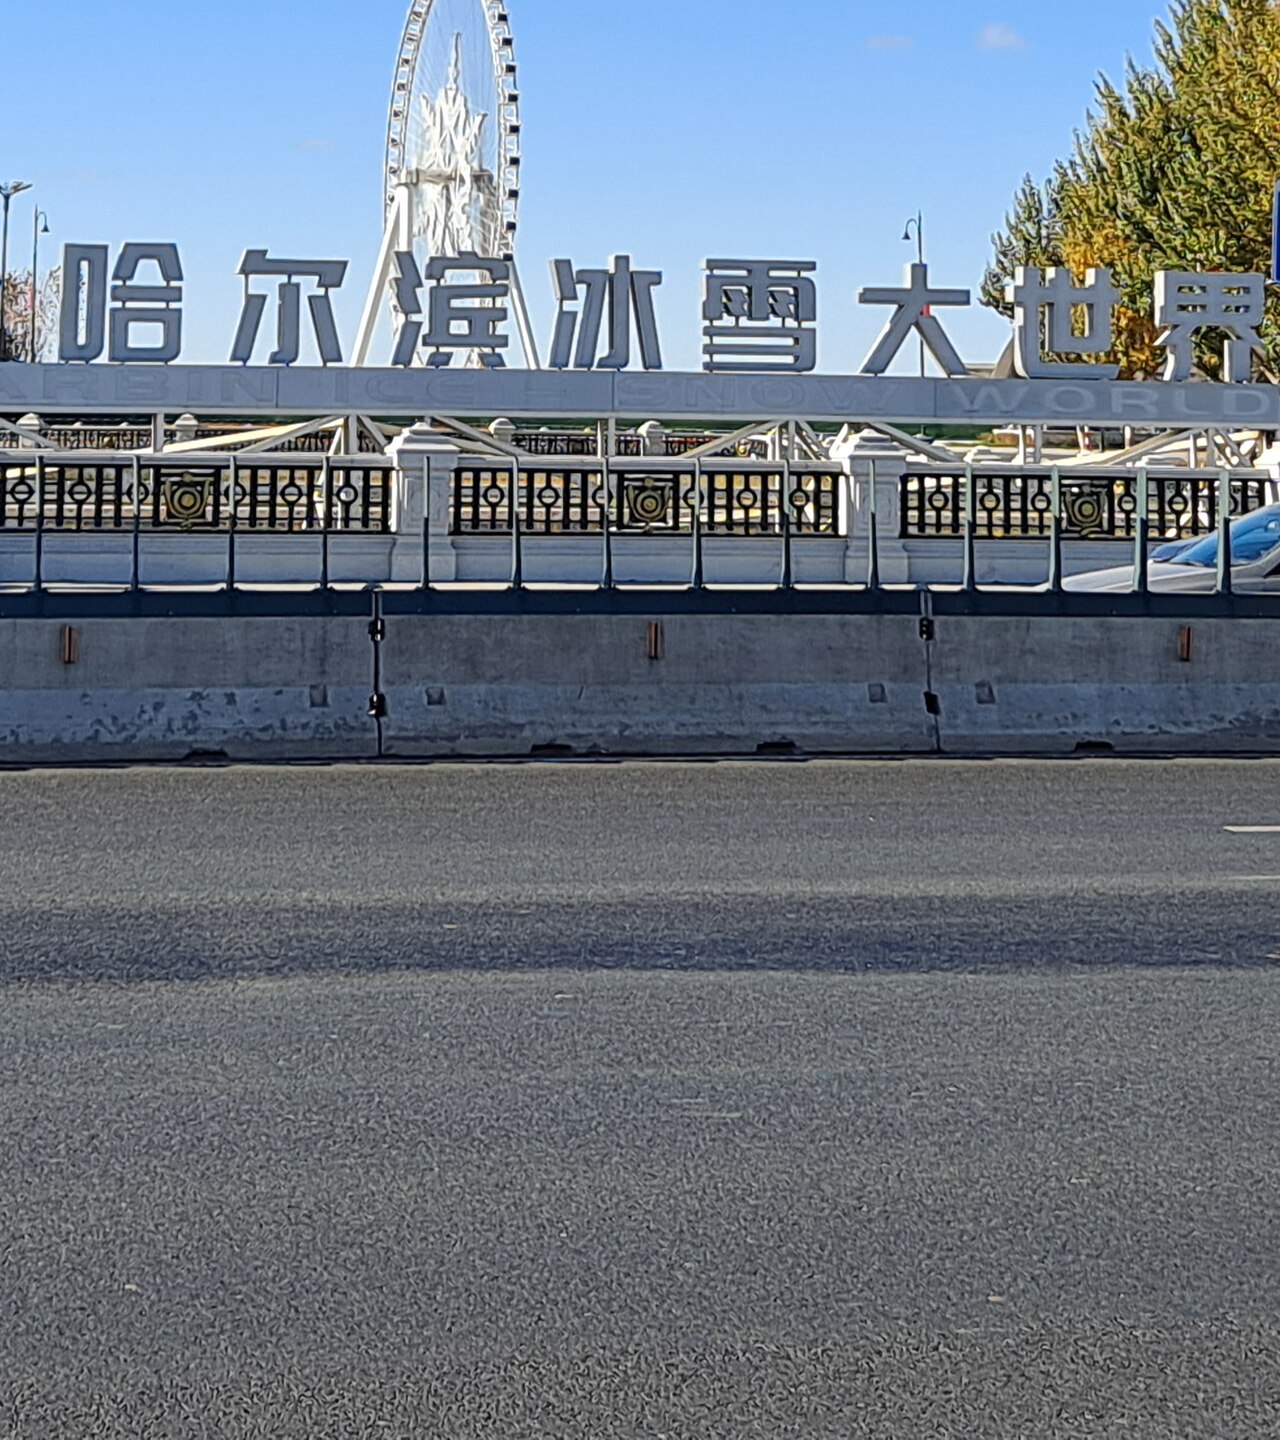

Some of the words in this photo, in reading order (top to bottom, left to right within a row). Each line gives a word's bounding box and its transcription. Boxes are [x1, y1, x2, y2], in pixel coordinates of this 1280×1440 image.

[59, 241, 1266, 383] 哈尔滨冰雪大世界
[334, 370, 475, 405] ICE
[616, 375, 902, 412] SNOW
[951, 383, 1271, 416] WORLD
